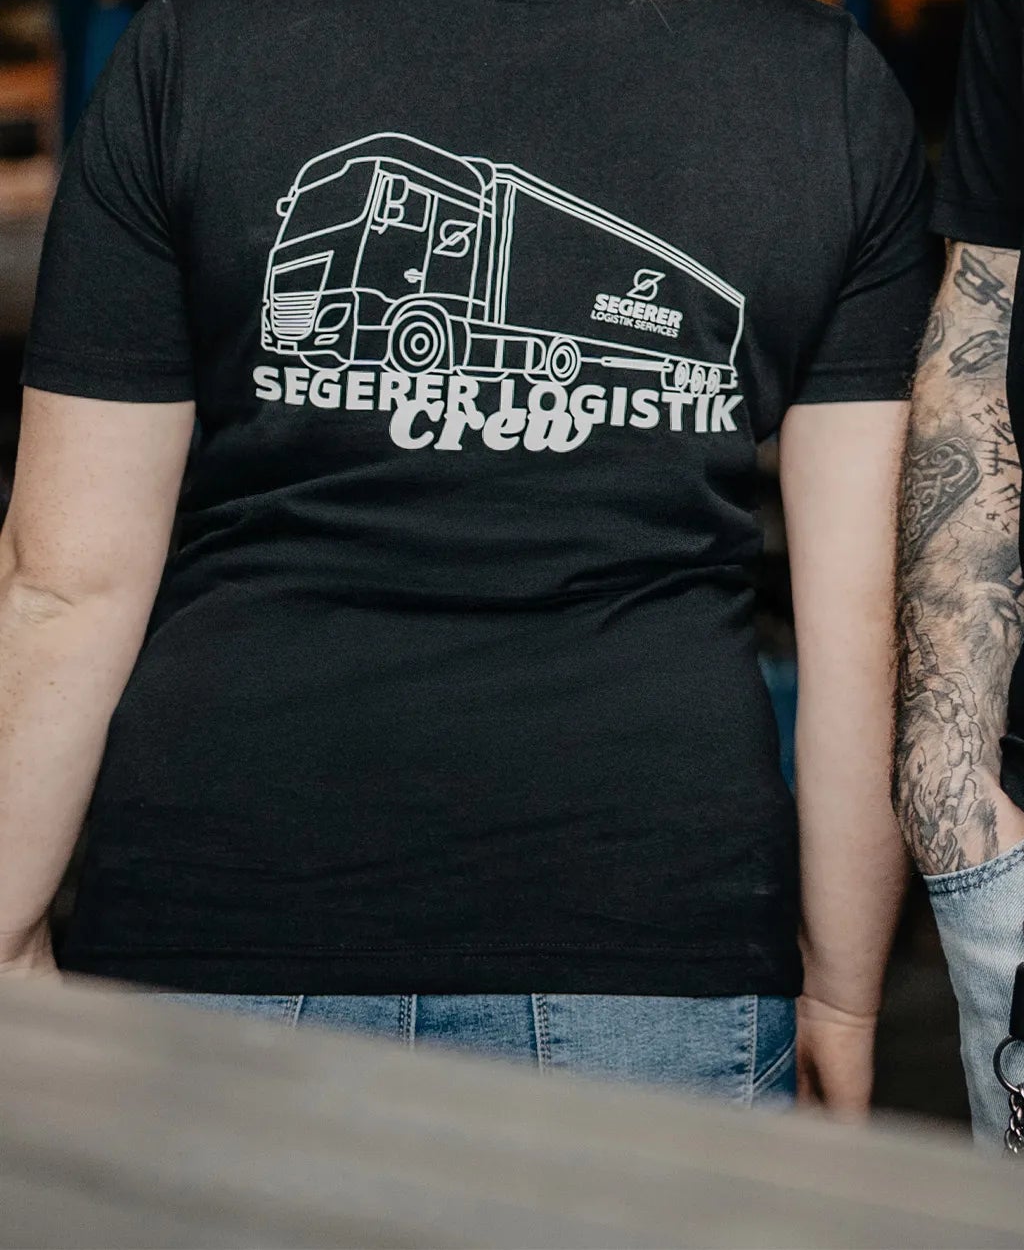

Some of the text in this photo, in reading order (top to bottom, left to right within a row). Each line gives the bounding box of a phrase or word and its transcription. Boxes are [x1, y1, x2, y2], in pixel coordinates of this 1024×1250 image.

[590, 310, 679, 338] LOGISTIK SERVICES
[593, 293, 683, 328] SEGERER
[252, 366, 744, 433] SEGERER LOGISTIK
[389, 398, 593, 453] Crew
